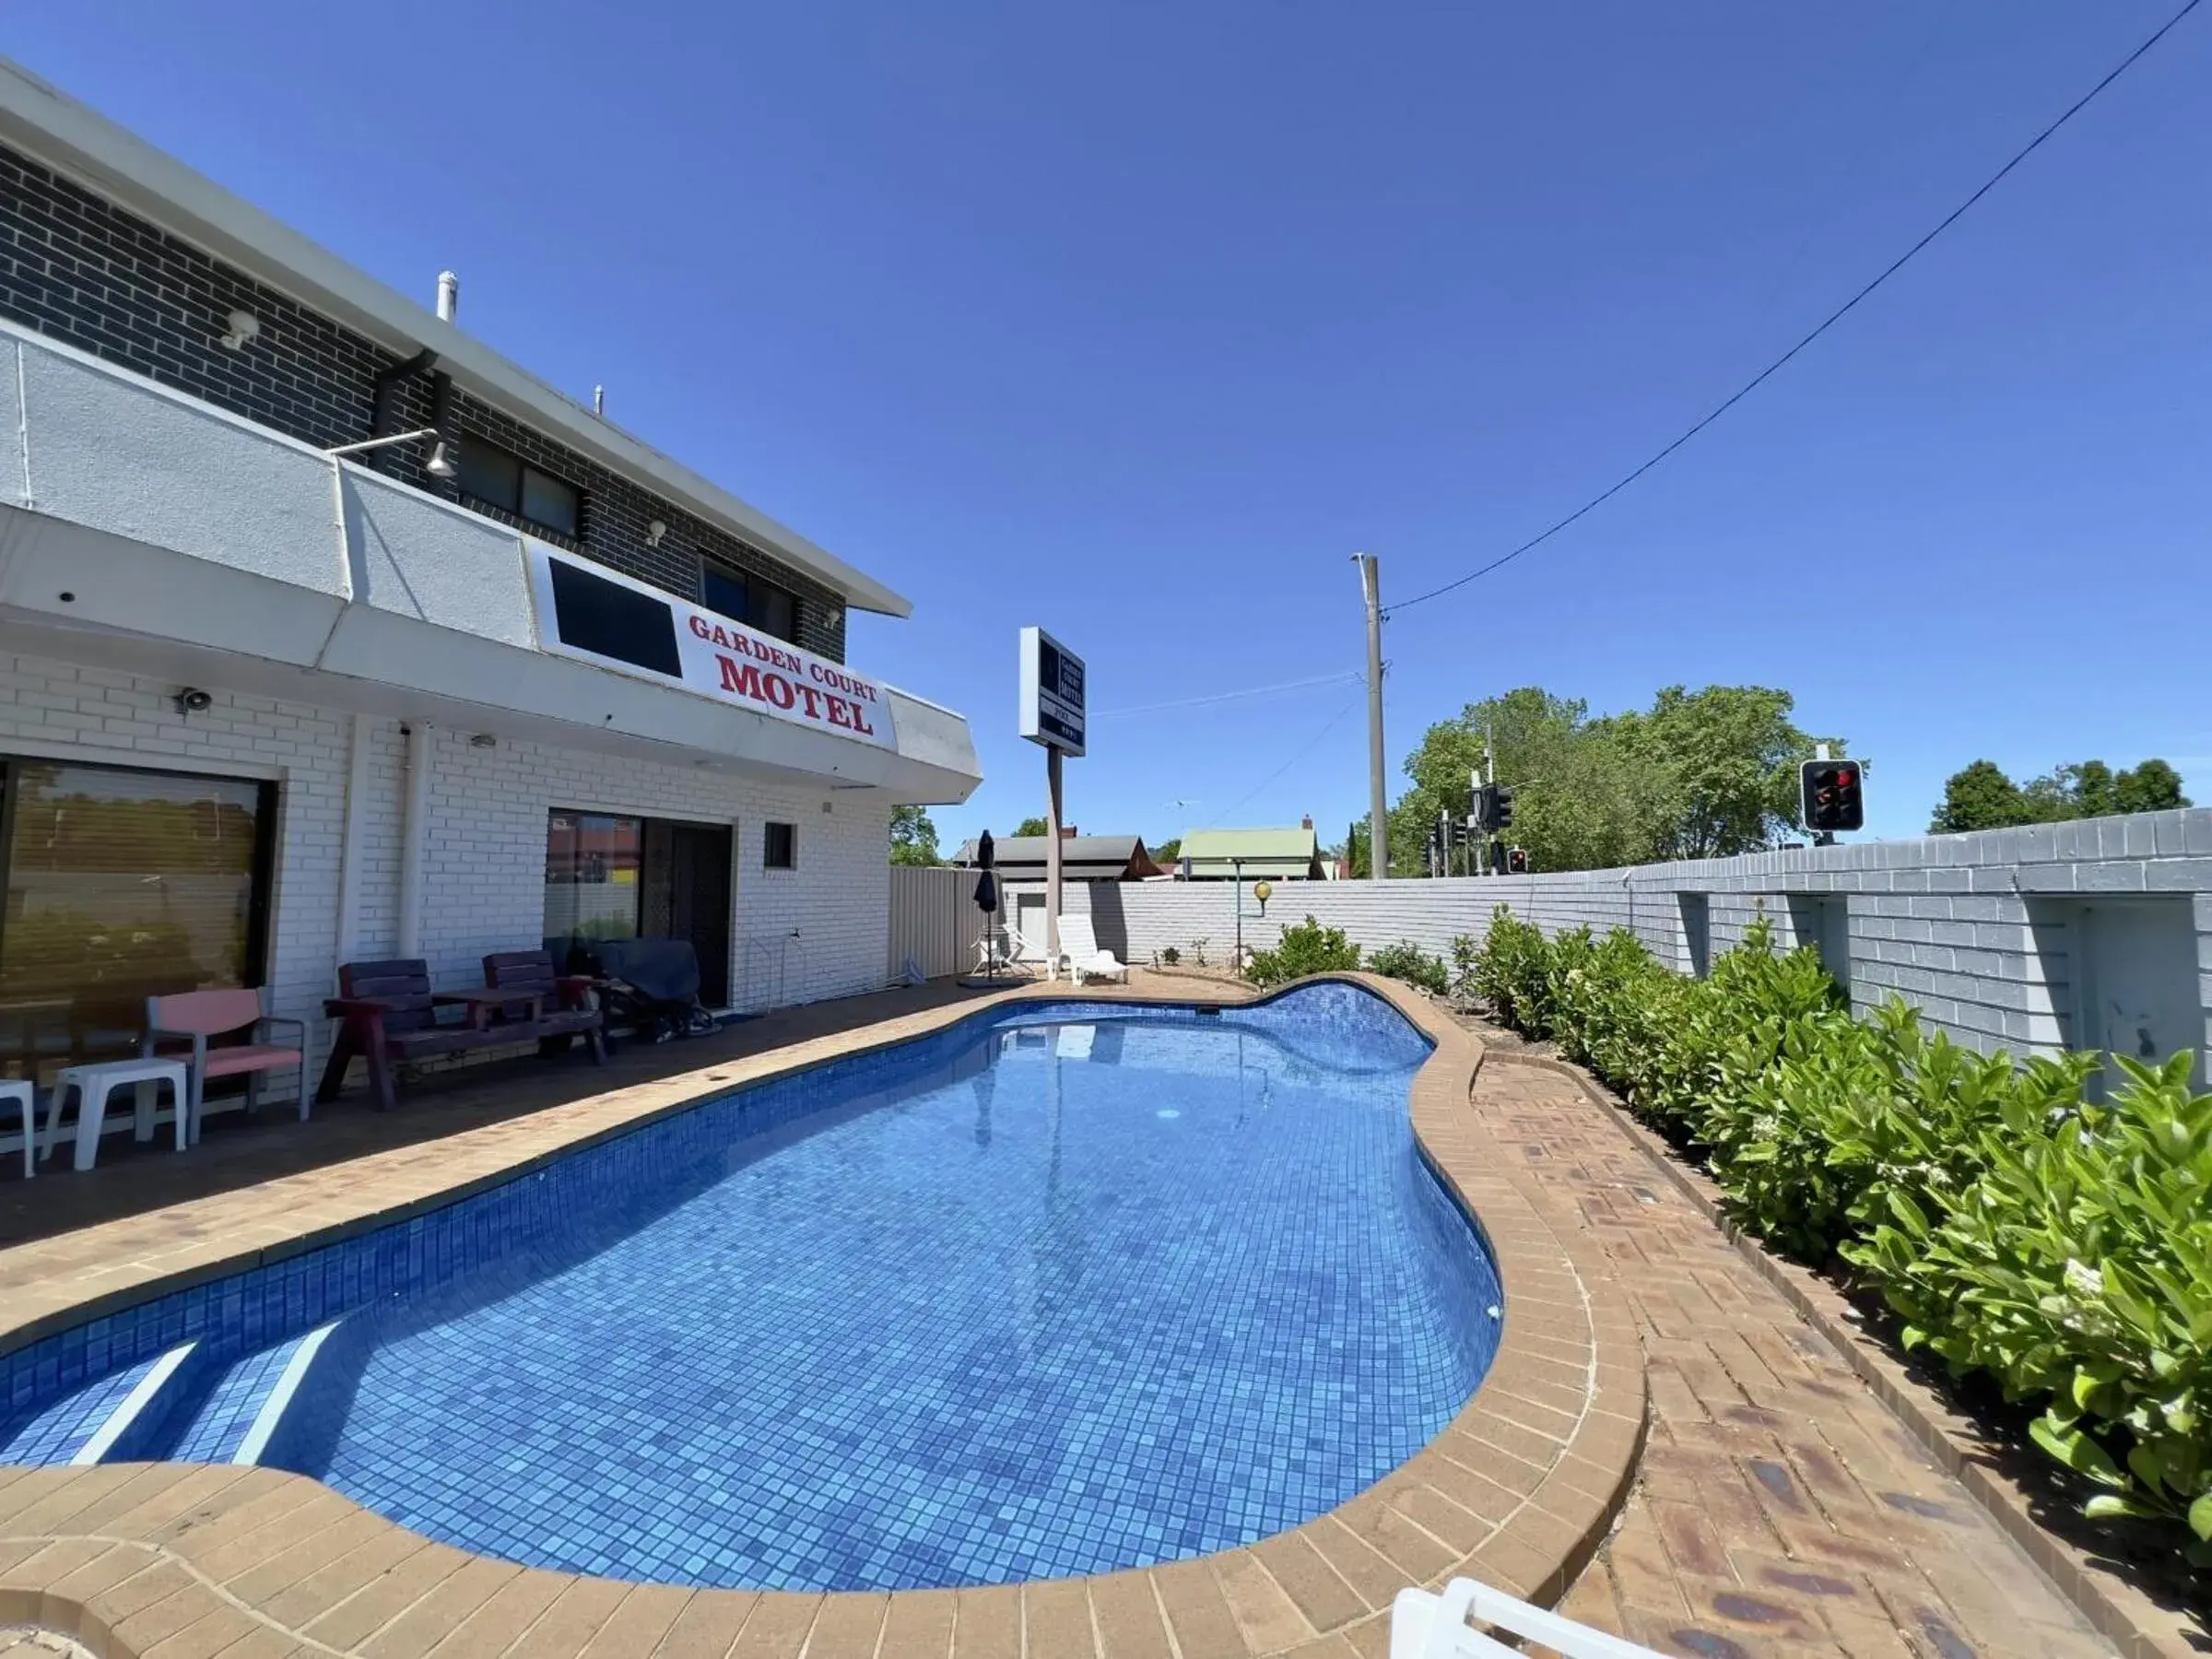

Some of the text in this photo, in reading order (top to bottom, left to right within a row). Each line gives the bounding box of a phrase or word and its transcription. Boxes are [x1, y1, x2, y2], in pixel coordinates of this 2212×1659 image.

[689, 615, 877, 702] GARDEN COURT
[715, 653, 874, 735] MOTEL
